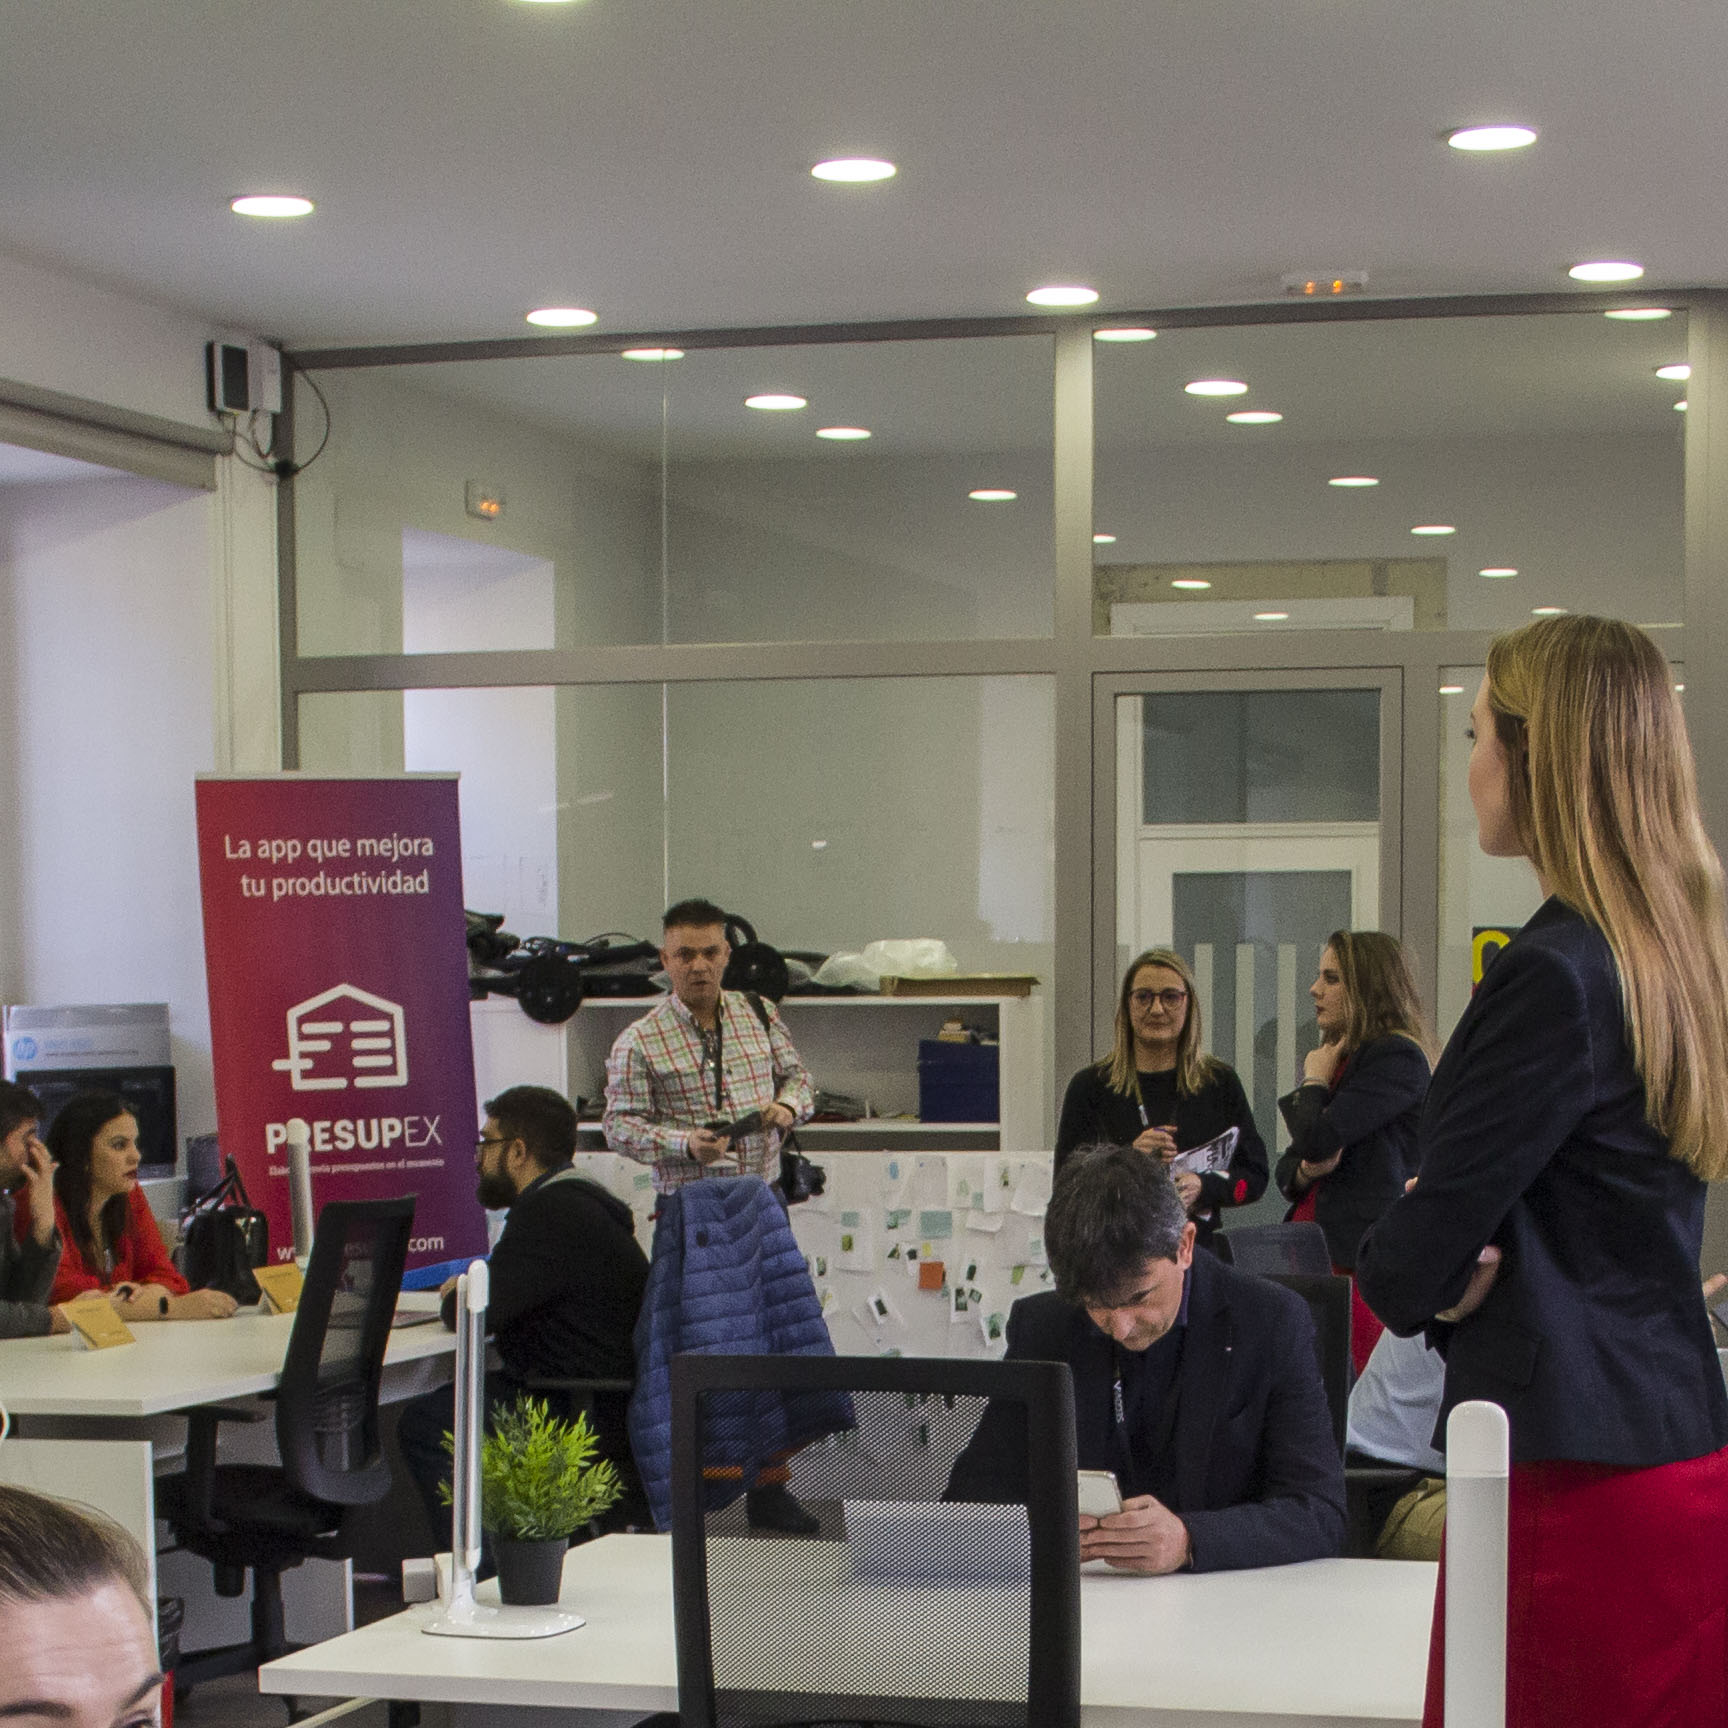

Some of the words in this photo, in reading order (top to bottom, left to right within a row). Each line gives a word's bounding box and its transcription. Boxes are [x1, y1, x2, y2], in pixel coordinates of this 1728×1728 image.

[225, 835, 254, 860] La
[257, 840, 301, 863] app
[307, 838, 351, 863] que
[356, 833, 433, 863] mejora
[241, 874, 265, 897] tu
[272, 869, 429, 902] productividad
